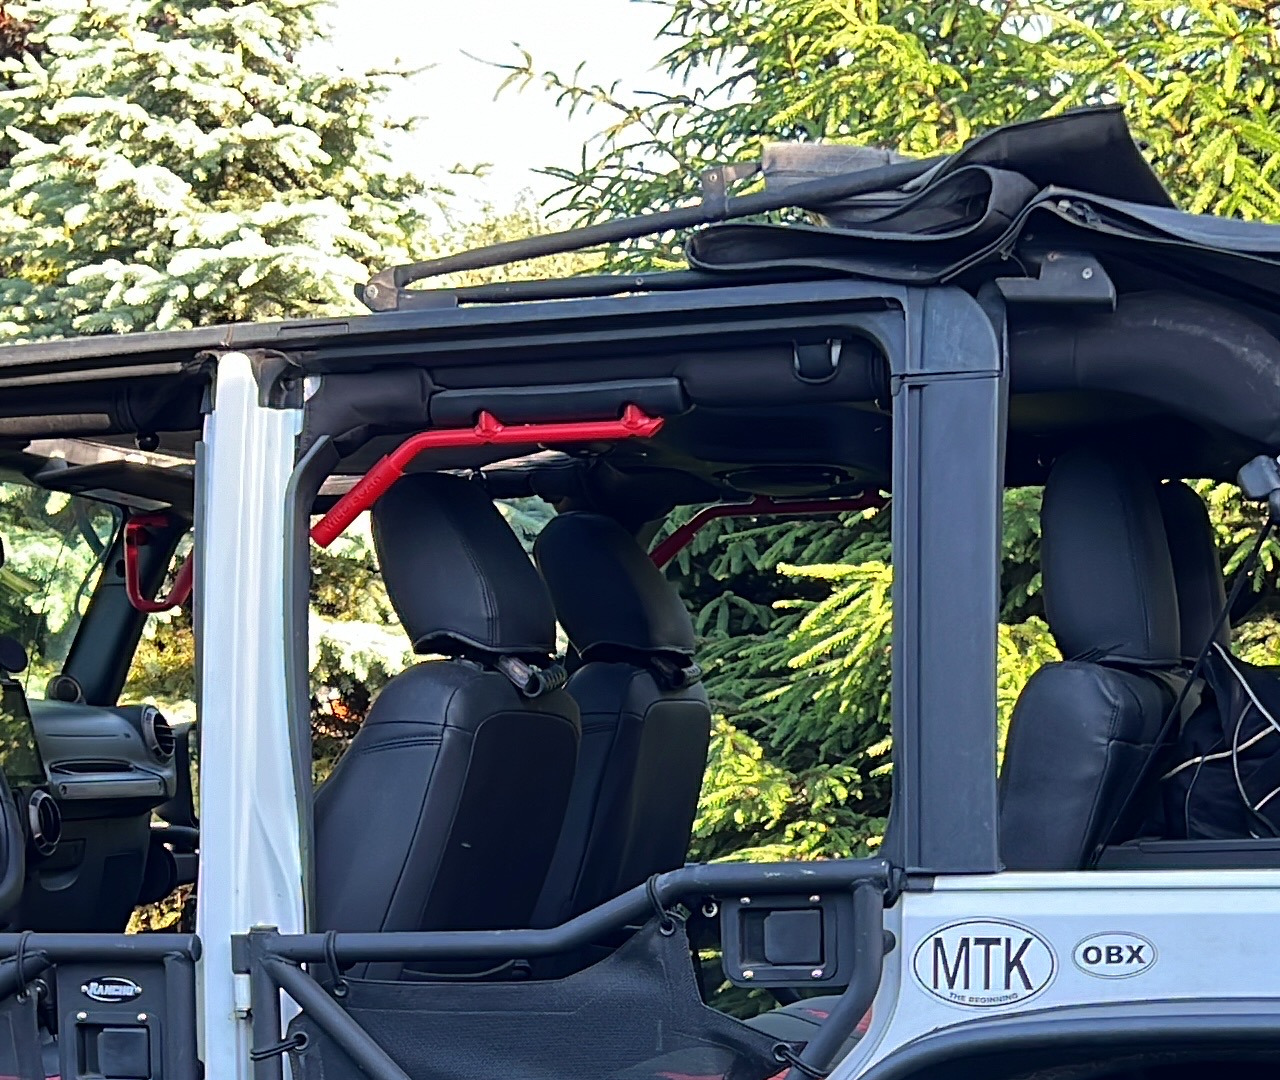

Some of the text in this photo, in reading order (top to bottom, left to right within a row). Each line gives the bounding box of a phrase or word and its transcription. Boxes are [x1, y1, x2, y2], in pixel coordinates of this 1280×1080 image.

[932, 937, 1034, 991] MTK
[1082, 945, 1147, 965] OBX
[949, 992, 1019, 1004] THE BEGINNING
